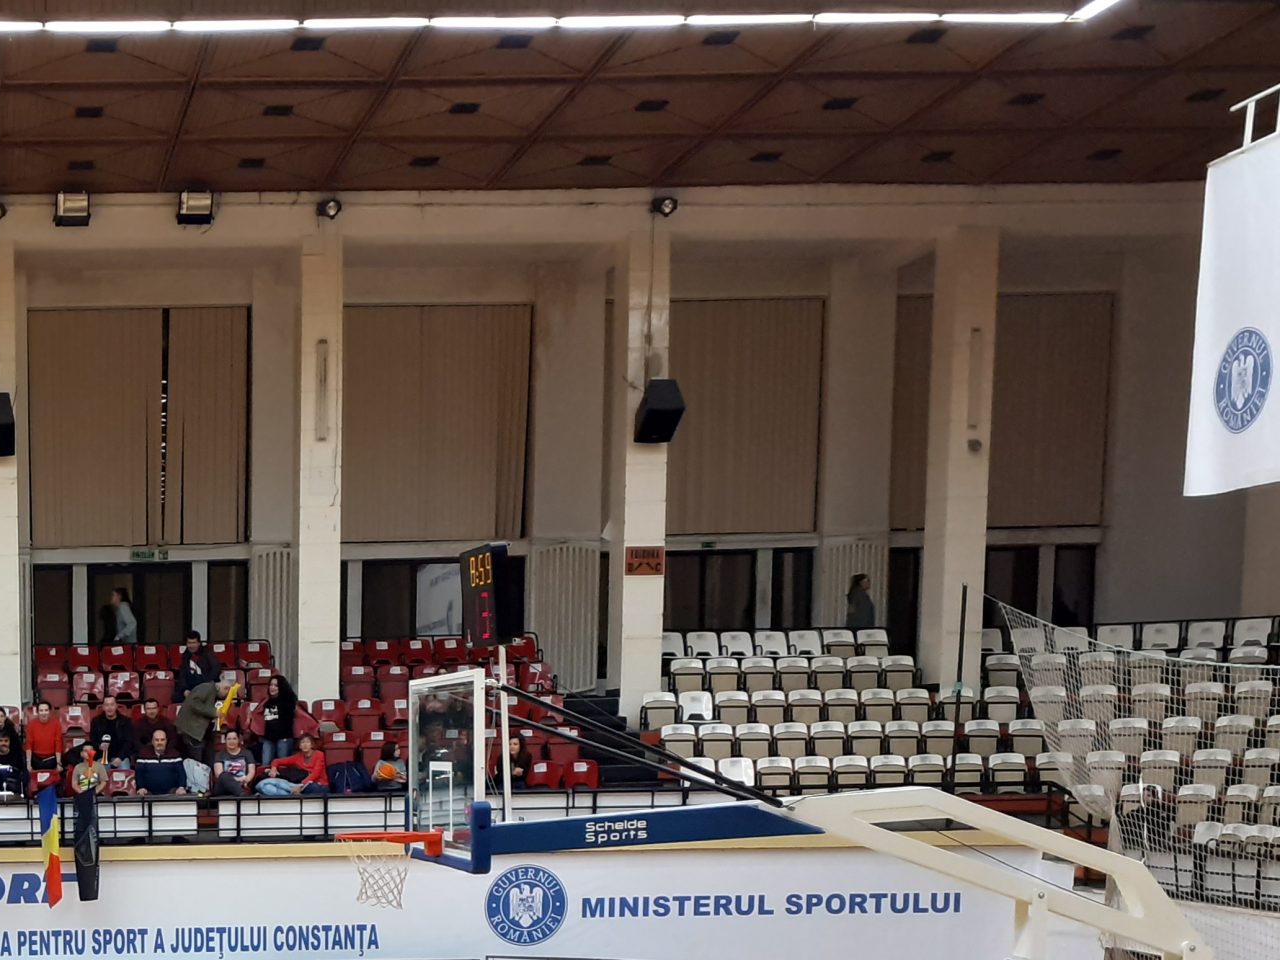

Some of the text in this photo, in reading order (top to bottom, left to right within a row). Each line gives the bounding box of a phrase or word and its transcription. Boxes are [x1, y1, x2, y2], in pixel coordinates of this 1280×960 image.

[585, 819, 648, 832] Schelde
[585, 830, 649, 844] Sports
[492, 868, 561, 896] GUVERNUL
[580, 891, 962, 919] MINISTERUL SPORTULUI
[17, 928, 86, 957] PENTRU
[91, 927, 149, 956] SPORT
[153, 927, 166, 954] A
